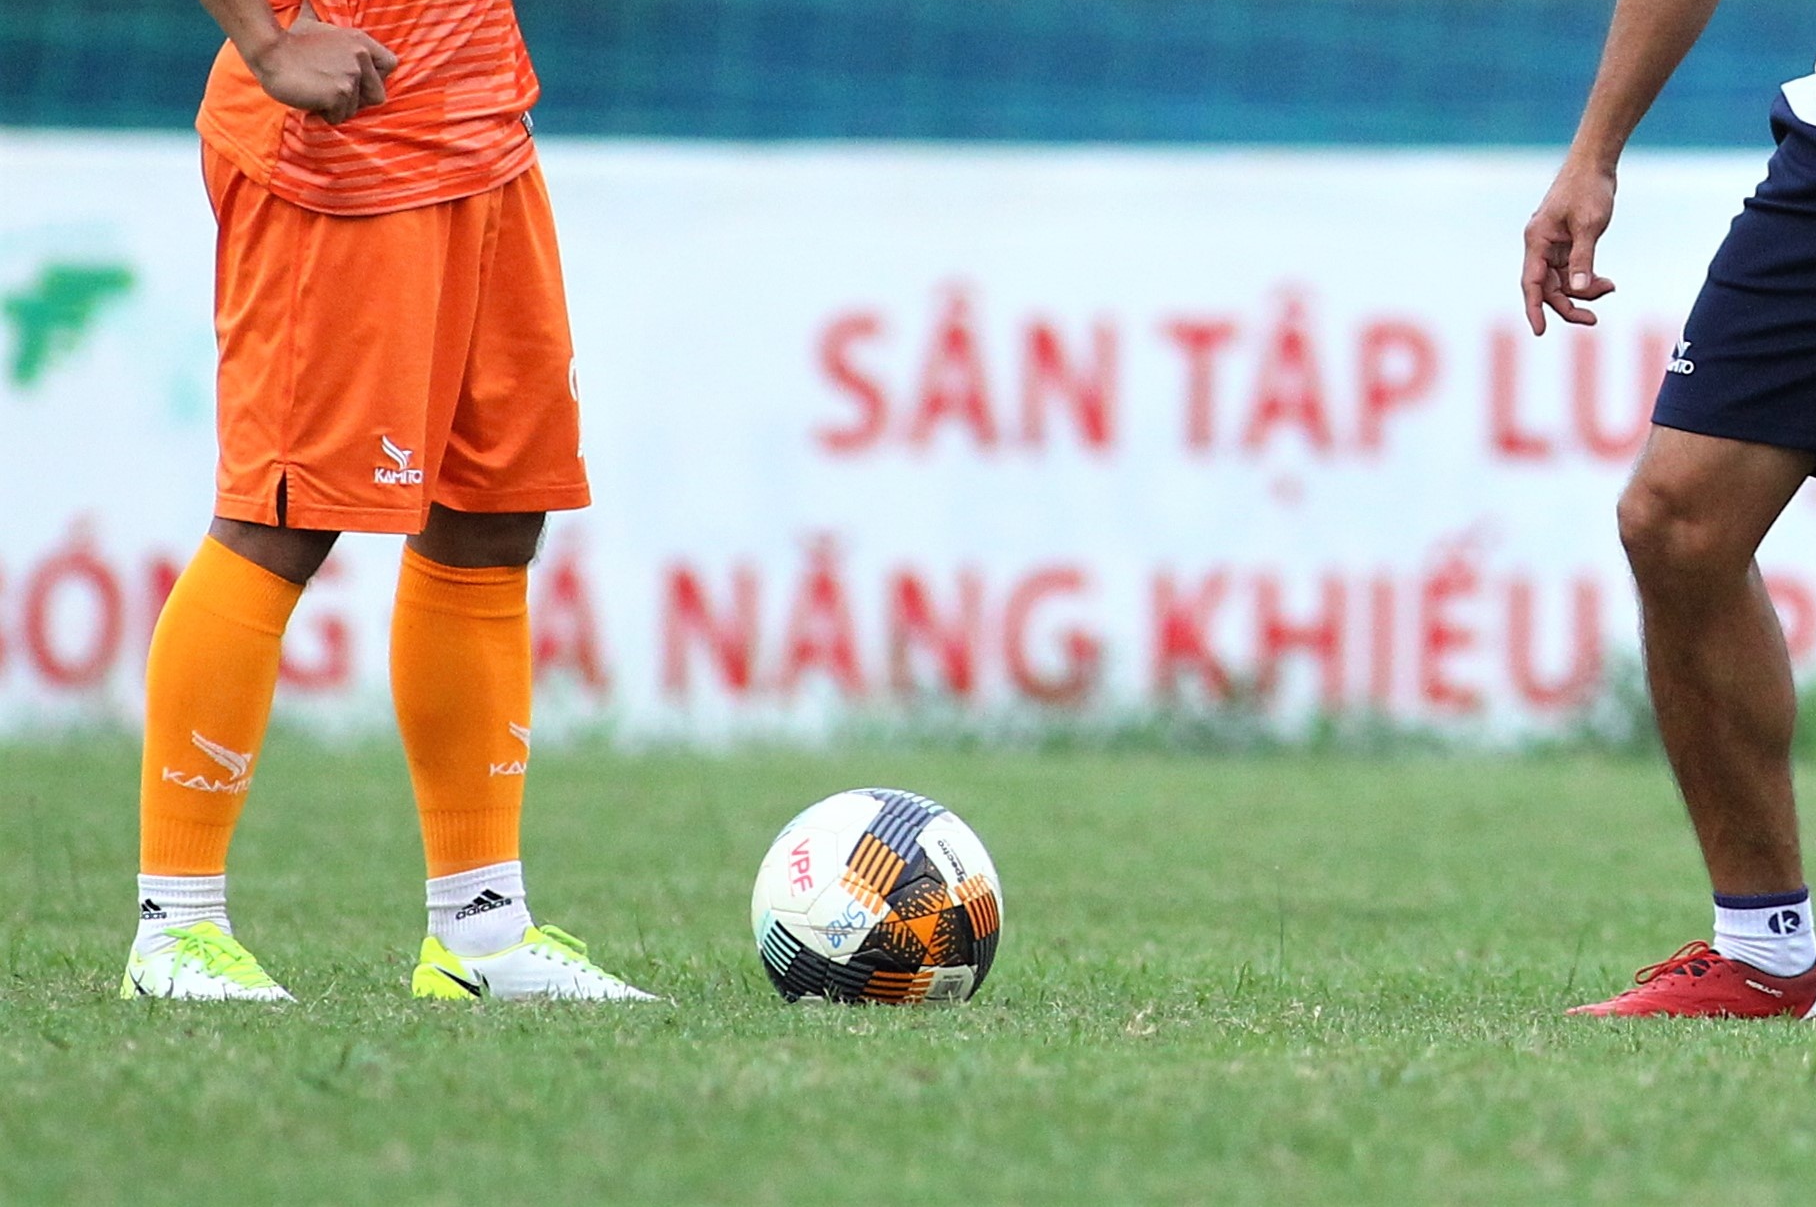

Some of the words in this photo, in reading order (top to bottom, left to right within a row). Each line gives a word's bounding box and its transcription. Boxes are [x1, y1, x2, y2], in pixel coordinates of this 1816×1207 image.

[816, 285, 1118, 455] SÂN
[1161, 286, 1440, 504] TẬP
[374, 467, 423, 485] KAMITO
[1148, 516, 1605, 711] KHIẾU
[790, 837, 814, 893] VPF
[455, 897, 513, 921] adidas
